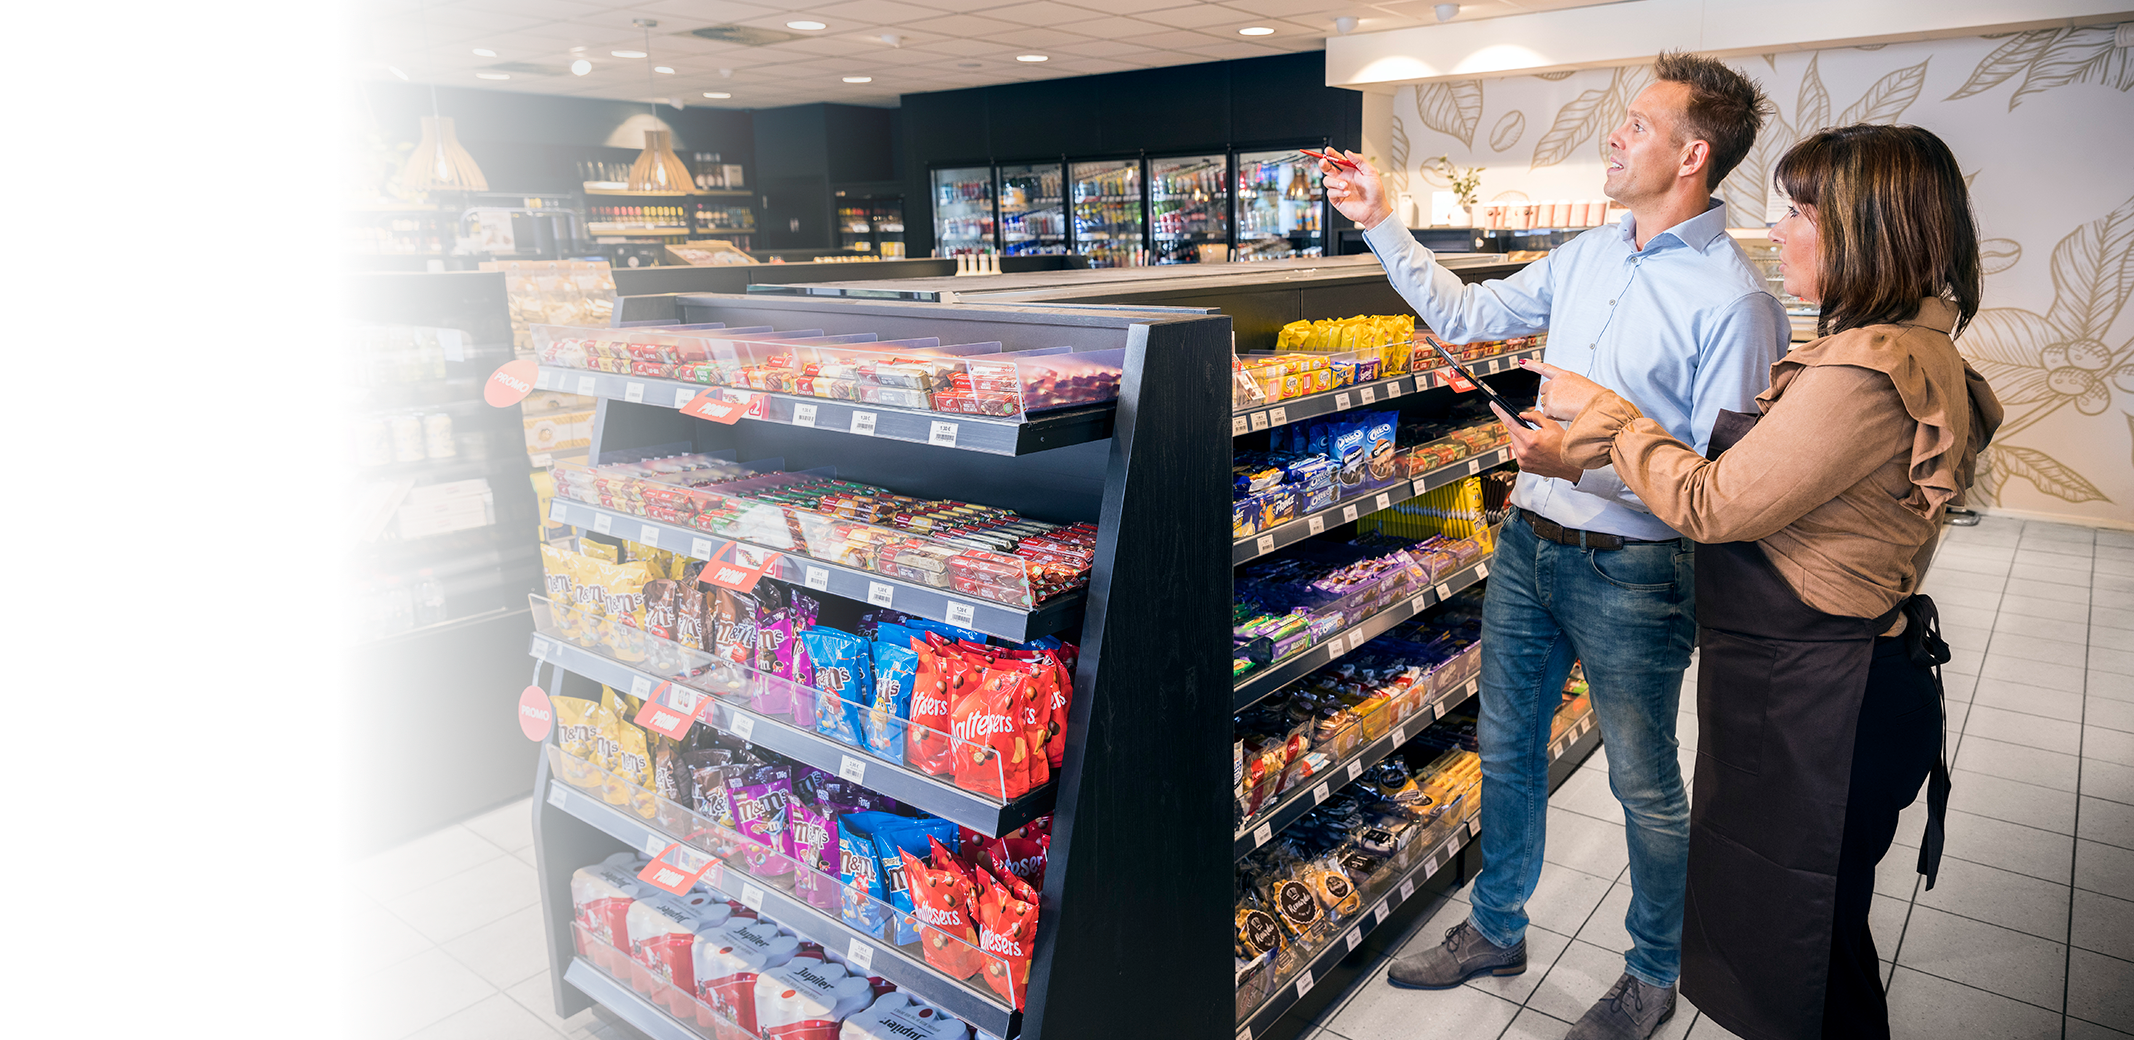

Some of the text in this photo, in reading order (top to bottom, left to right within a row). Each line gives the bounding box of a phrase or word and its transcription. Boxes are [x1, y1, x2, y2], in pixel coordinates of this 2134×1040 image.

[494, 371, 530, 394] PROMO
[696, 402, 733, 418] PROMO
[1336, 430, 1362, 448] OREO
[1370, 424, 1390, 440] OREO
[714, 566, 748, 586] PROMO
[605, 592, 644, 615] m&m's
[521, 704, 550, 722] PROMO
[649, 710, 681, 732] PROMO
[558, 724, 597, 742] m&m's
[736, 788, 789, 824] m&m's
[652, 867, 686, 888] PROMO
[656, 905, 691, 924] Jupiler
[733, 926, 770, 948] Jupiler
[793, 966, 834, 990] Jupiler
[879, 1018, 928, 1040] Jupiler
